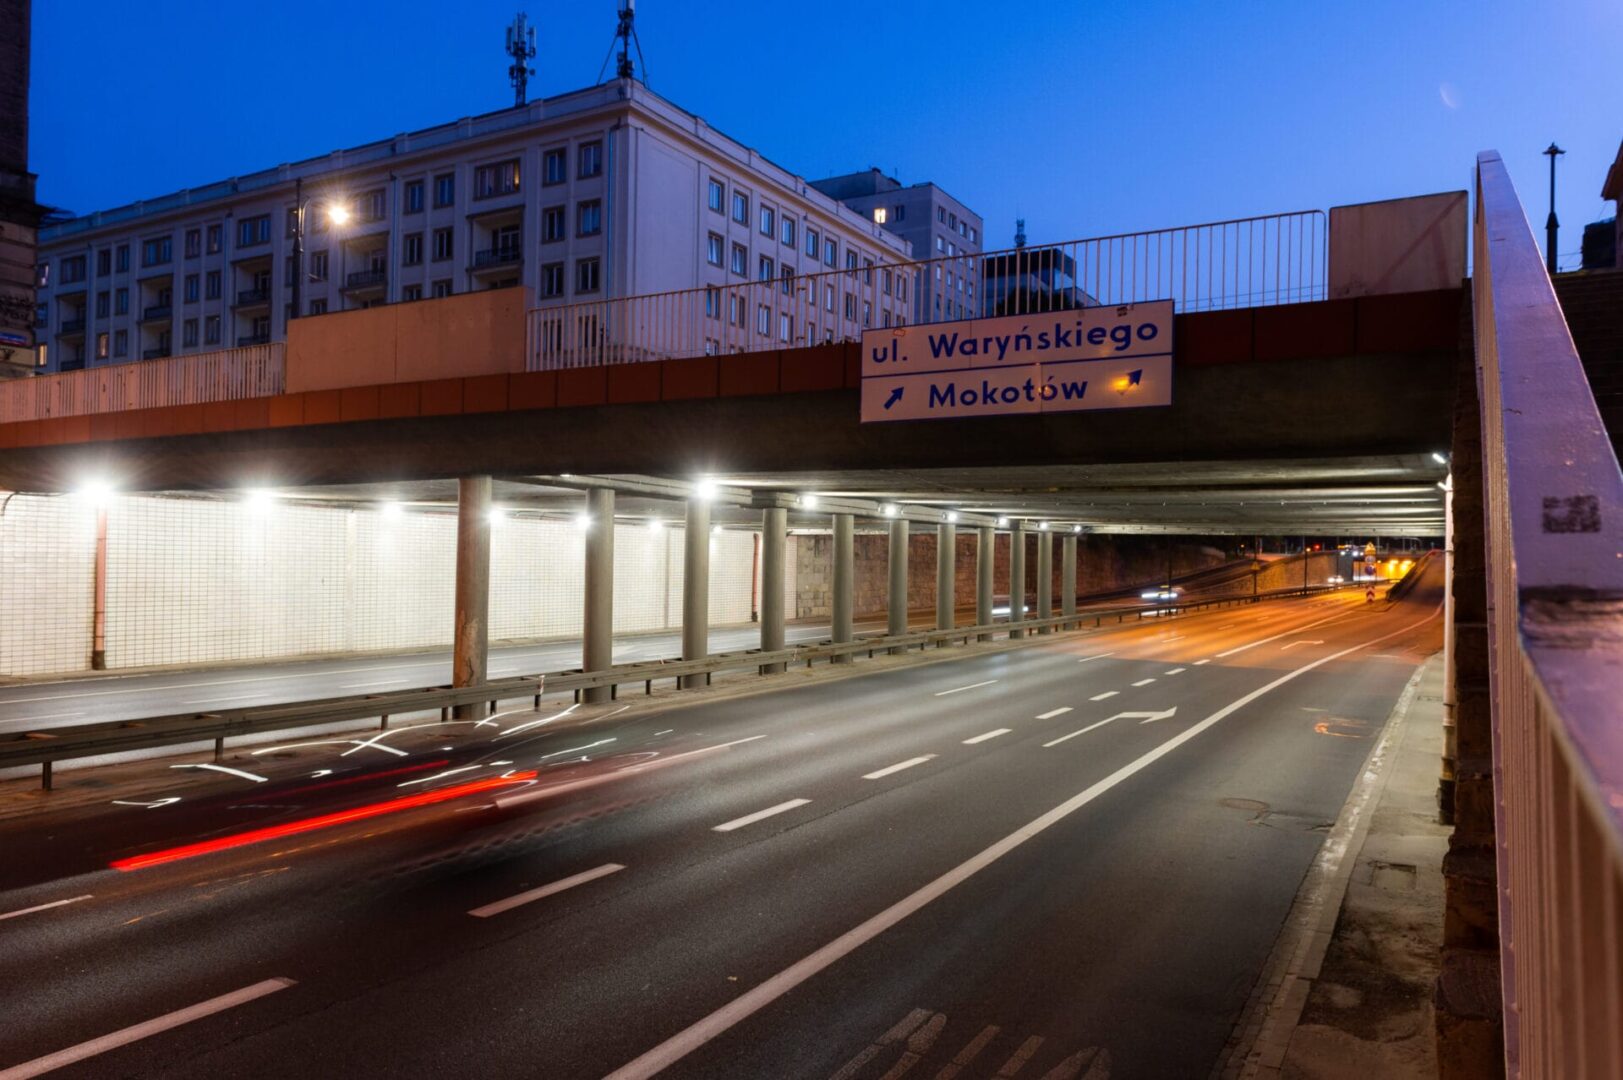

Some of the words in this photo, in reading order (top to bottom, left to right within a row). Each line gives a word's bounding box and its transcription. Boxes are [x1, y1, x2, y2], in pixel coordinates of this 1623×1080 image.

[872, 338, 908, 363] ul.
[928, 321, 1158, 361] Waryńskiego
[928, 376, 1088, 408] Mokotów
